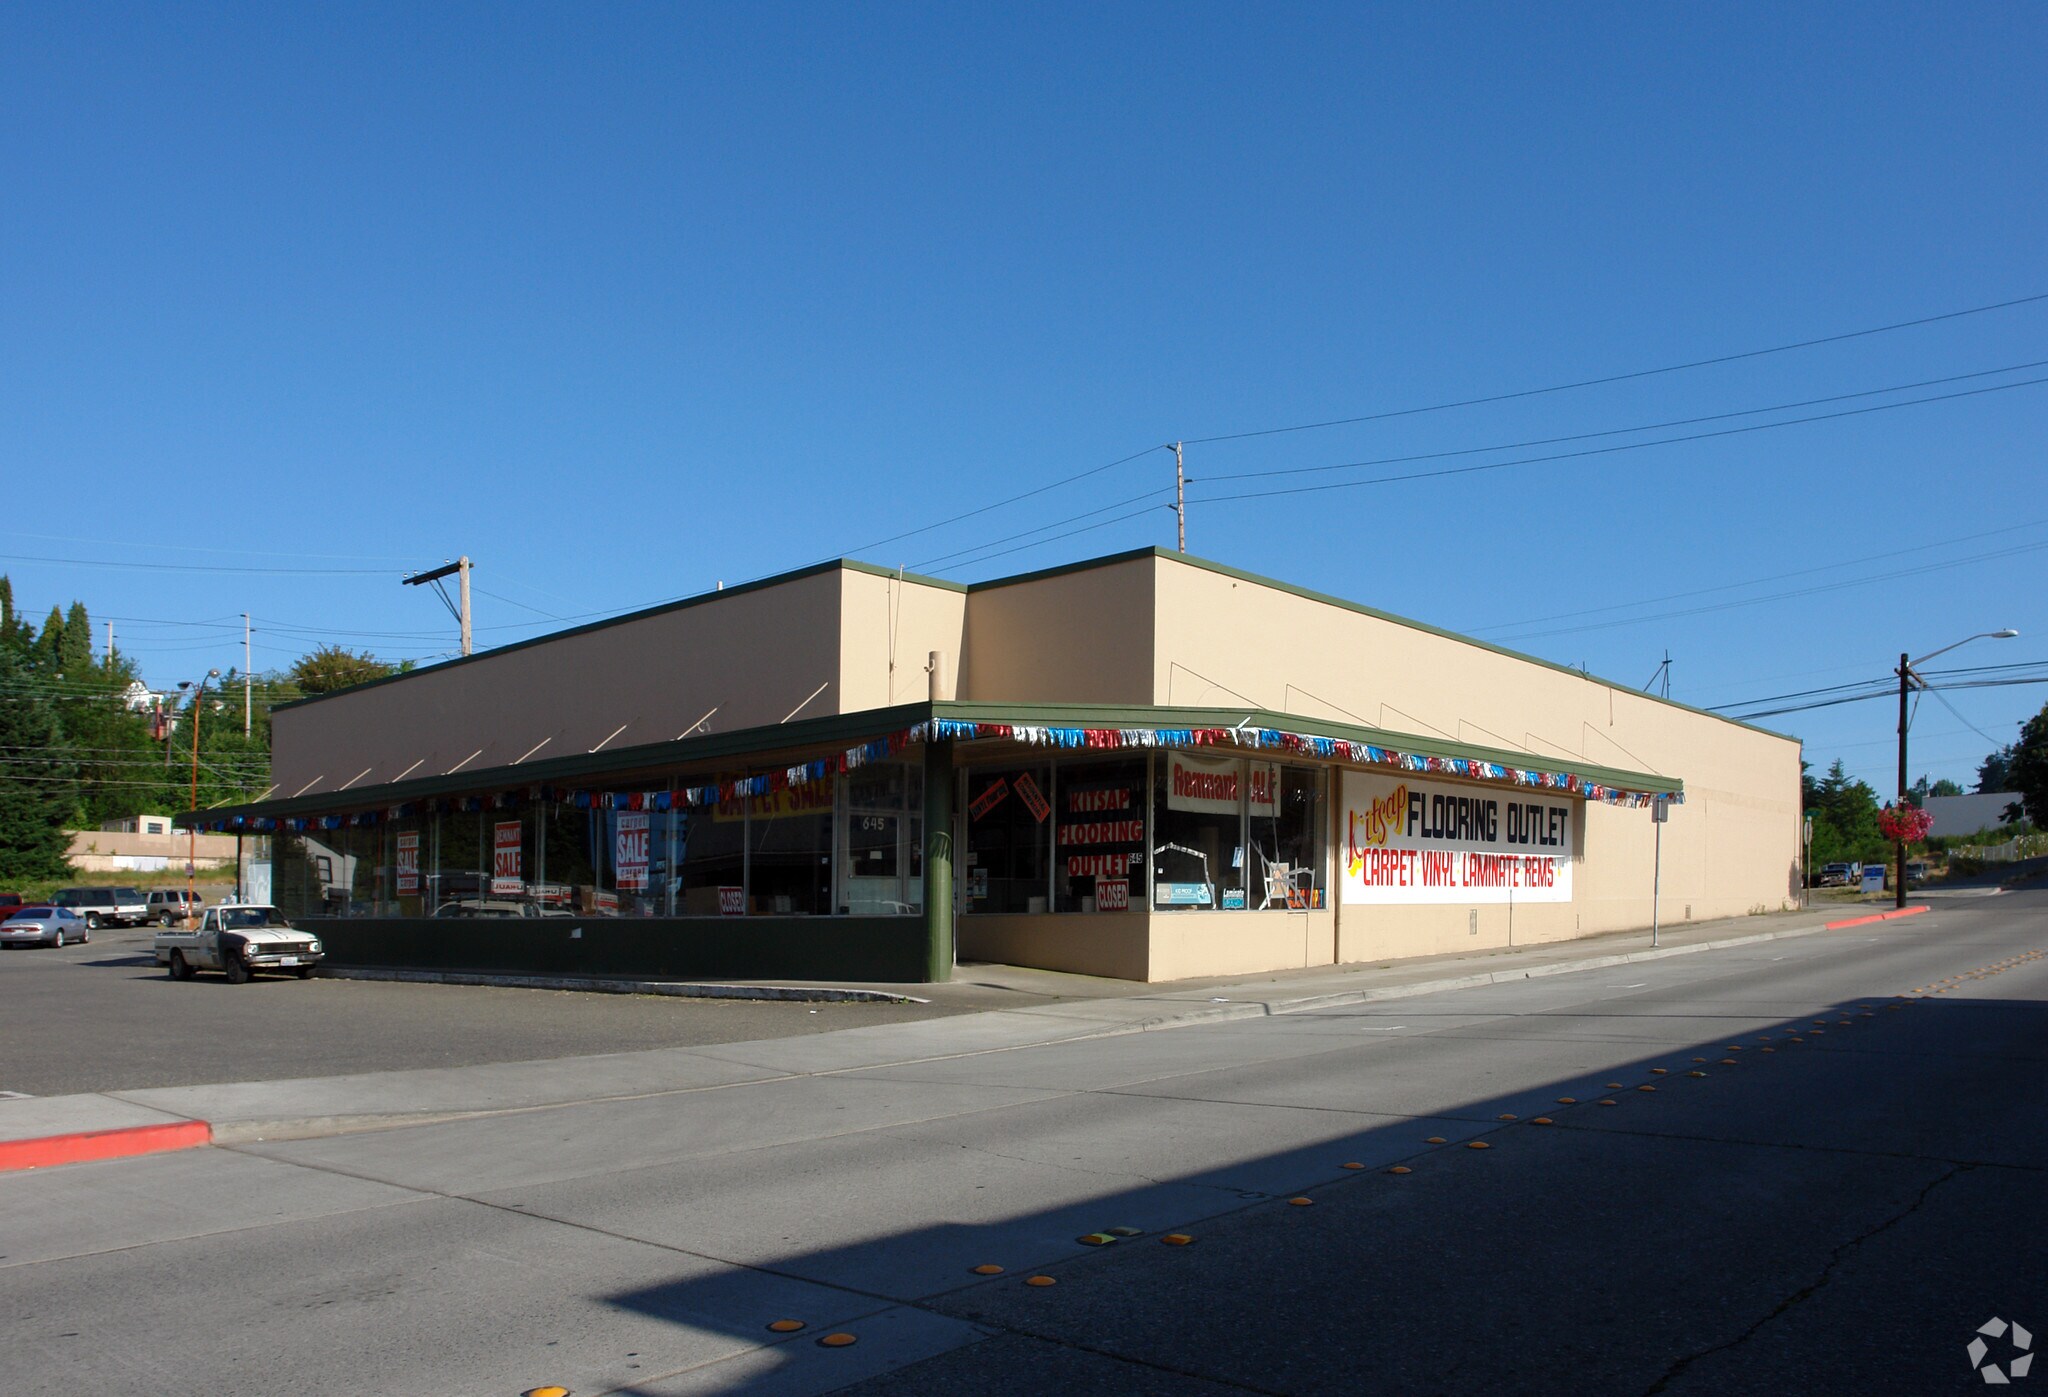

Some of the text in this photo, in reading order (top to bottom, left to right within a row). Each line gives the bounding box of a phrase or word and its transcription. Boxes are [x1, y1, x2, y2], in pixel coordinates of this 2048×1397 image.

[1173, 763, 1238, 800] Remnant
[1071, 788, 1129, 812] KITSAP
[863, 817, 884, 831] 645
[1058, 820, 1143, 845] FLOORING
[1347, 784, 1568, 870] Kitsap FLOORING OUTLET
[618, 833, 649, 863] SALE
[1128, 853, 1142, 863] 645
[398, 850, 419, 875] SALE
[496, 852, 521, 877] SALE
[1068, 854, 1128, 876] OUTLET
[1363, 848, 1554, 888] CARPET VINYL LAMINATE REMS
[720, 890, 744, 913] CLOSED
[1099, 883, 1128, 909] CLOSED
